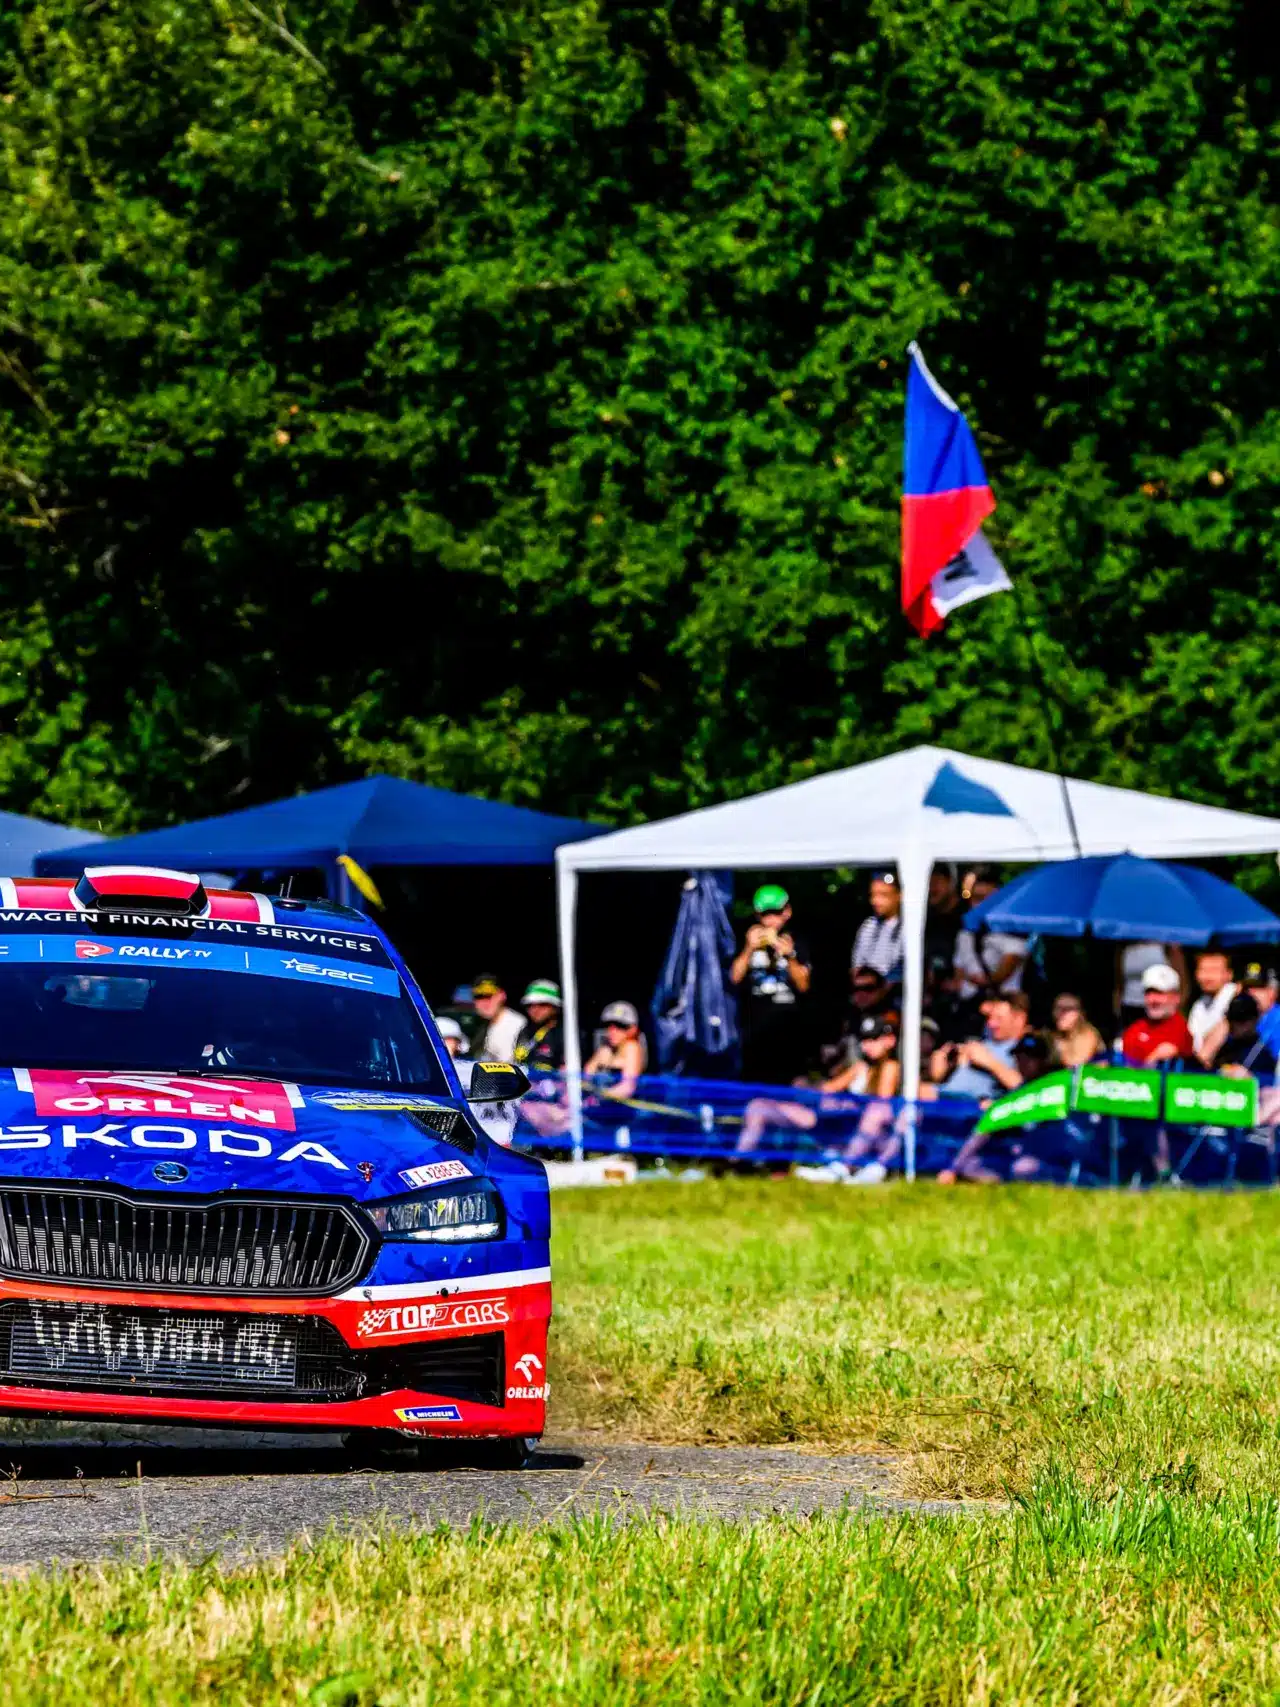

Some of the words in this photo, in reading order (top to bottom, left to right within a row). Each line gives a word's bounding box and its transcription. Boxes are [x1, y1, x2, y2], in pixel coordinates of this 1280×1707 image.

[108, 914, 248, 934] FINANCIAL
[256, 926, 373, 953] SERVICES
[53, 1097, 276, 1124] ORLEN
[451, 1302, 510, 1326] CARS
[506, 1386, 544, 1399] ORLEN
[416, 1410, 455, 1418] MICHELIN
